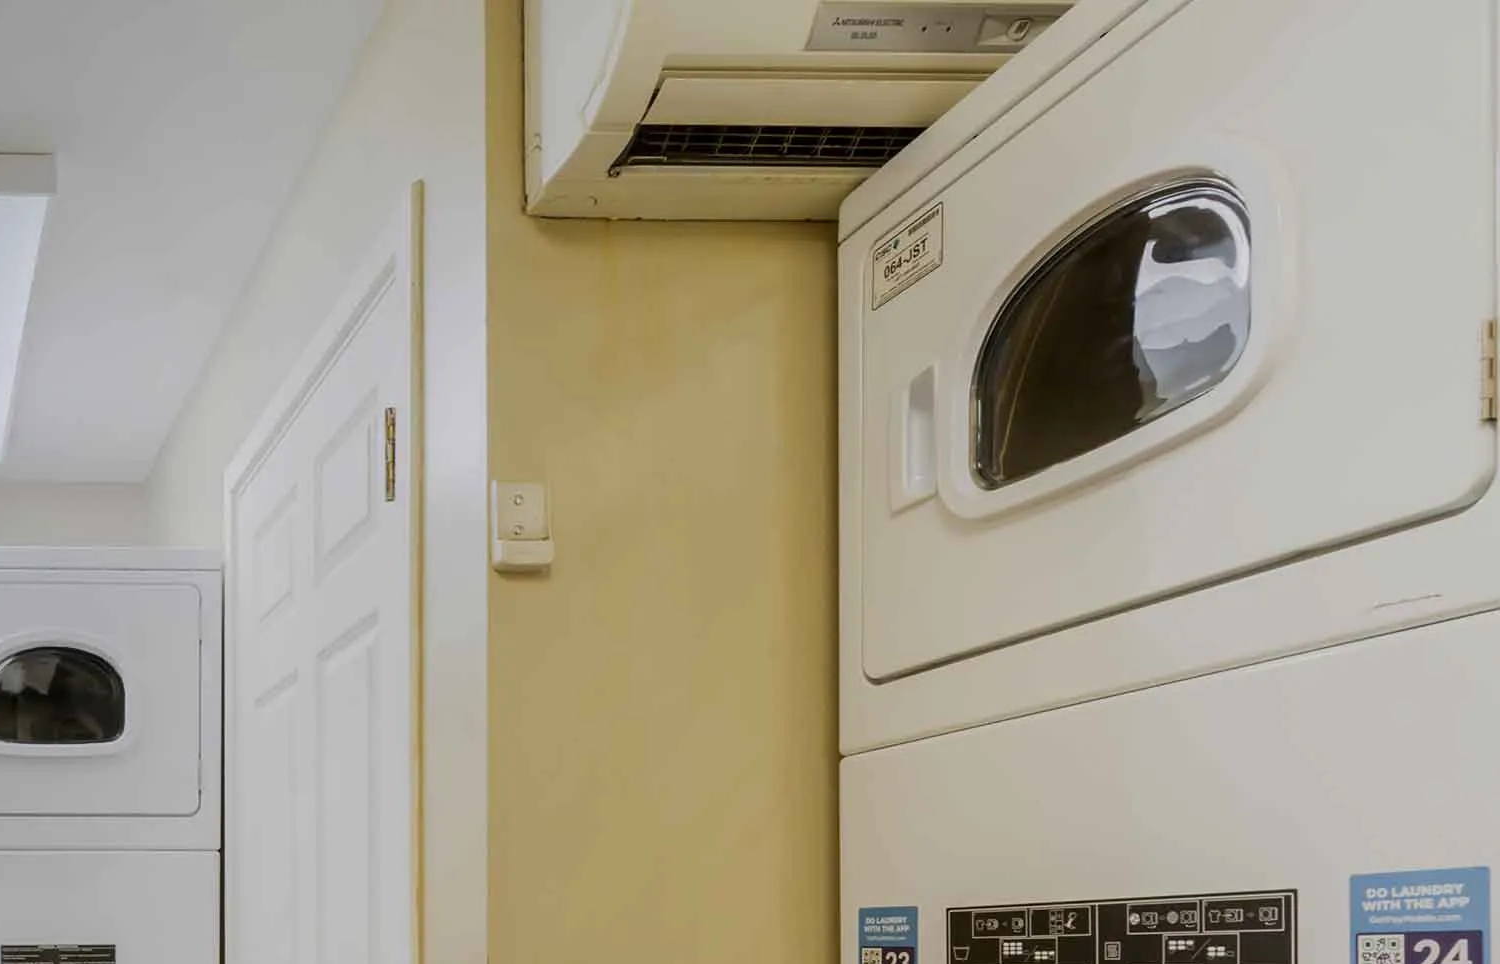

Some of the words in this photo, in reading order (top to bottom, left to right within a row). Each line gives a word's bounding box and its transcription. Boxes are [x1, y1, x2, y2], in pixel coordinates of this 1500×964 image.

[884, 236, 928, 279] 064-JST
[1366, 886, 1388, 899] DO
[1391, 883, 1465, 899] LAUNDRY
[1362, 899, 1401, 912] WITH
[1403, 898, 1434, 911] THE
[1436, 896, 1471, 909] APP
